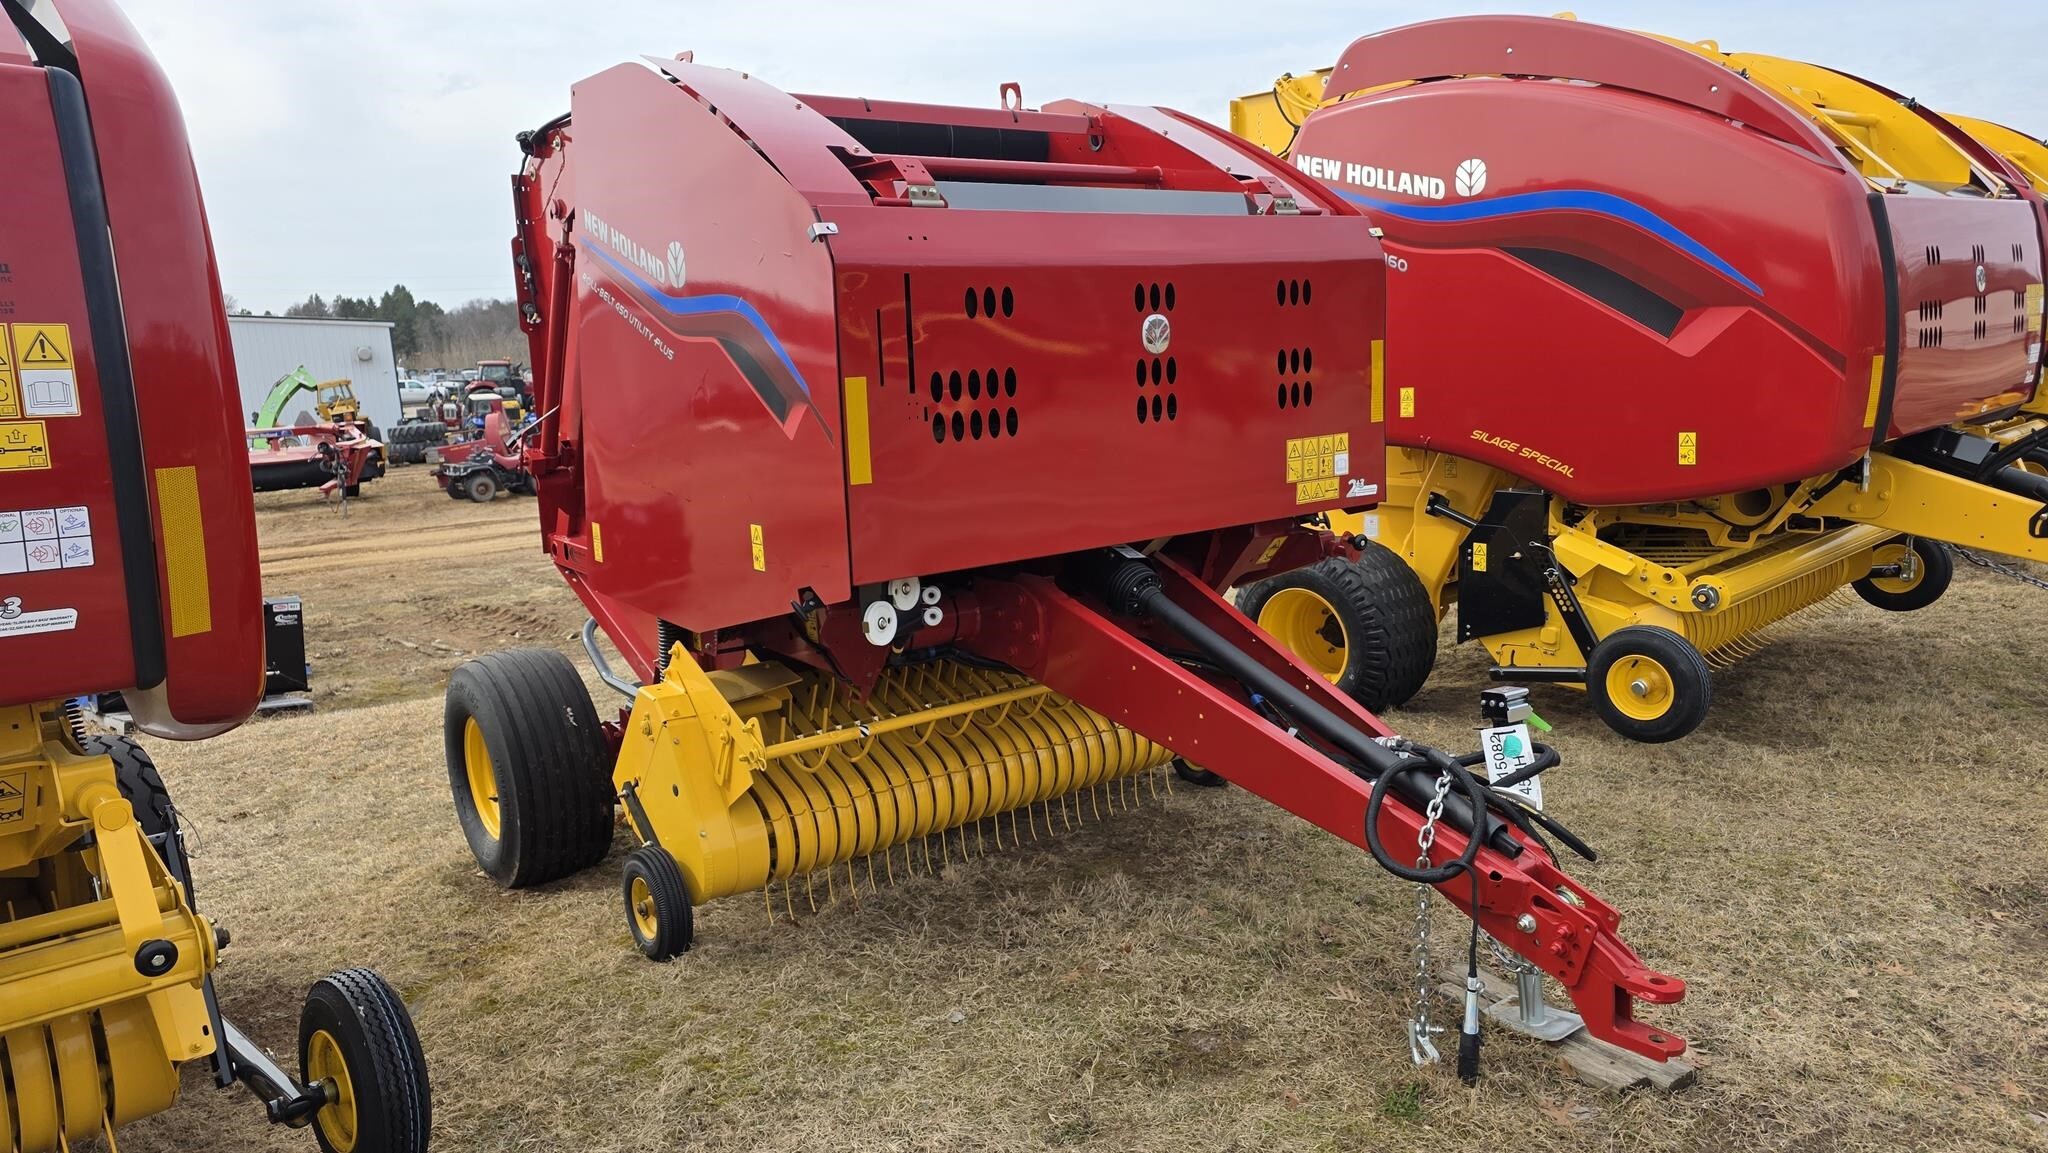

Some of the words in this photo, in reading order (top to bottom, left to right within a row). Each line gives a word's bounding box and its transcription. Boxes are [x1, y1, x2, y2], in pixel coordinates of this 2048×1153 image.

[1296, 154, 1341, 181] NEW
[1346, 163, 1446, 200] HOLLAND
[583, 208, 608, 244] NEW
[610, 227, 666, 285] HOLLAND
[615, 302, 629, 319] 450
[629, 313, 654, 341] UTILITY
[1470, 429, 1520, 453] SILAGE
[1518, 447, 1575, 479] SPECIAL
